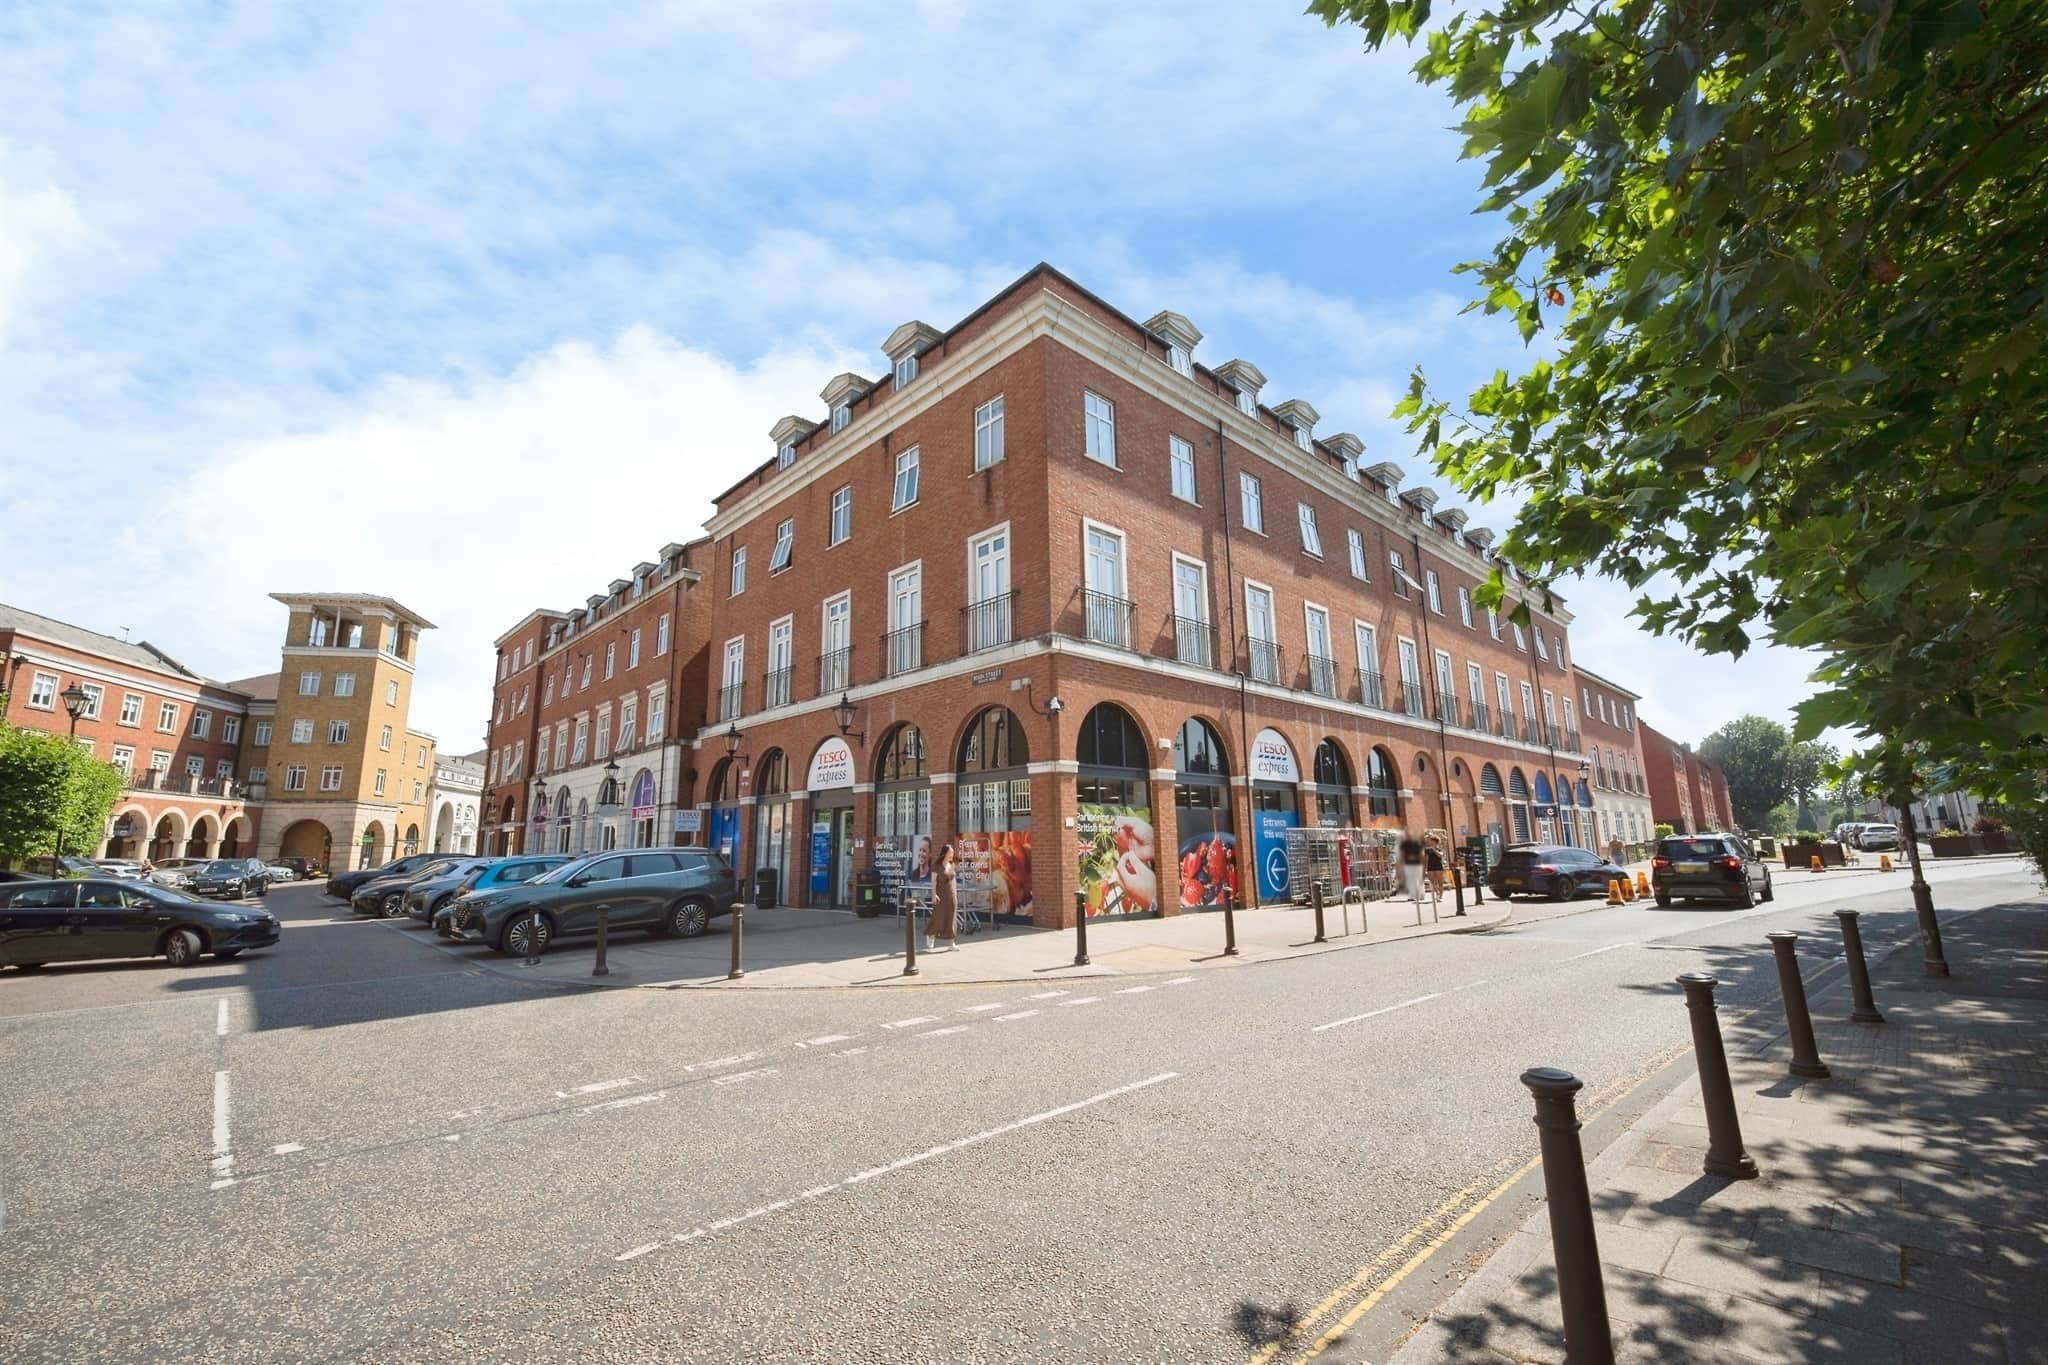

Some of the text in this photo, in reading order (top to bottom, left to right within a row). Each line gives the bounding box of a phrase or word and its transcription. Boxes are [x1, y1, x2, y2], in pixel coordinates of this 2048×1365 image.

[1257, 742, 1287, 756] TESCO
[818, 750, 847, 764] TESCO
[1258, 761, 1289, 776] express
[817, 769, 847, 784] express
[1076, 823, 1098, 832] British
[1263, 817, 1287, 827] Entrance
[1264, 830, 1285, 841] this way
